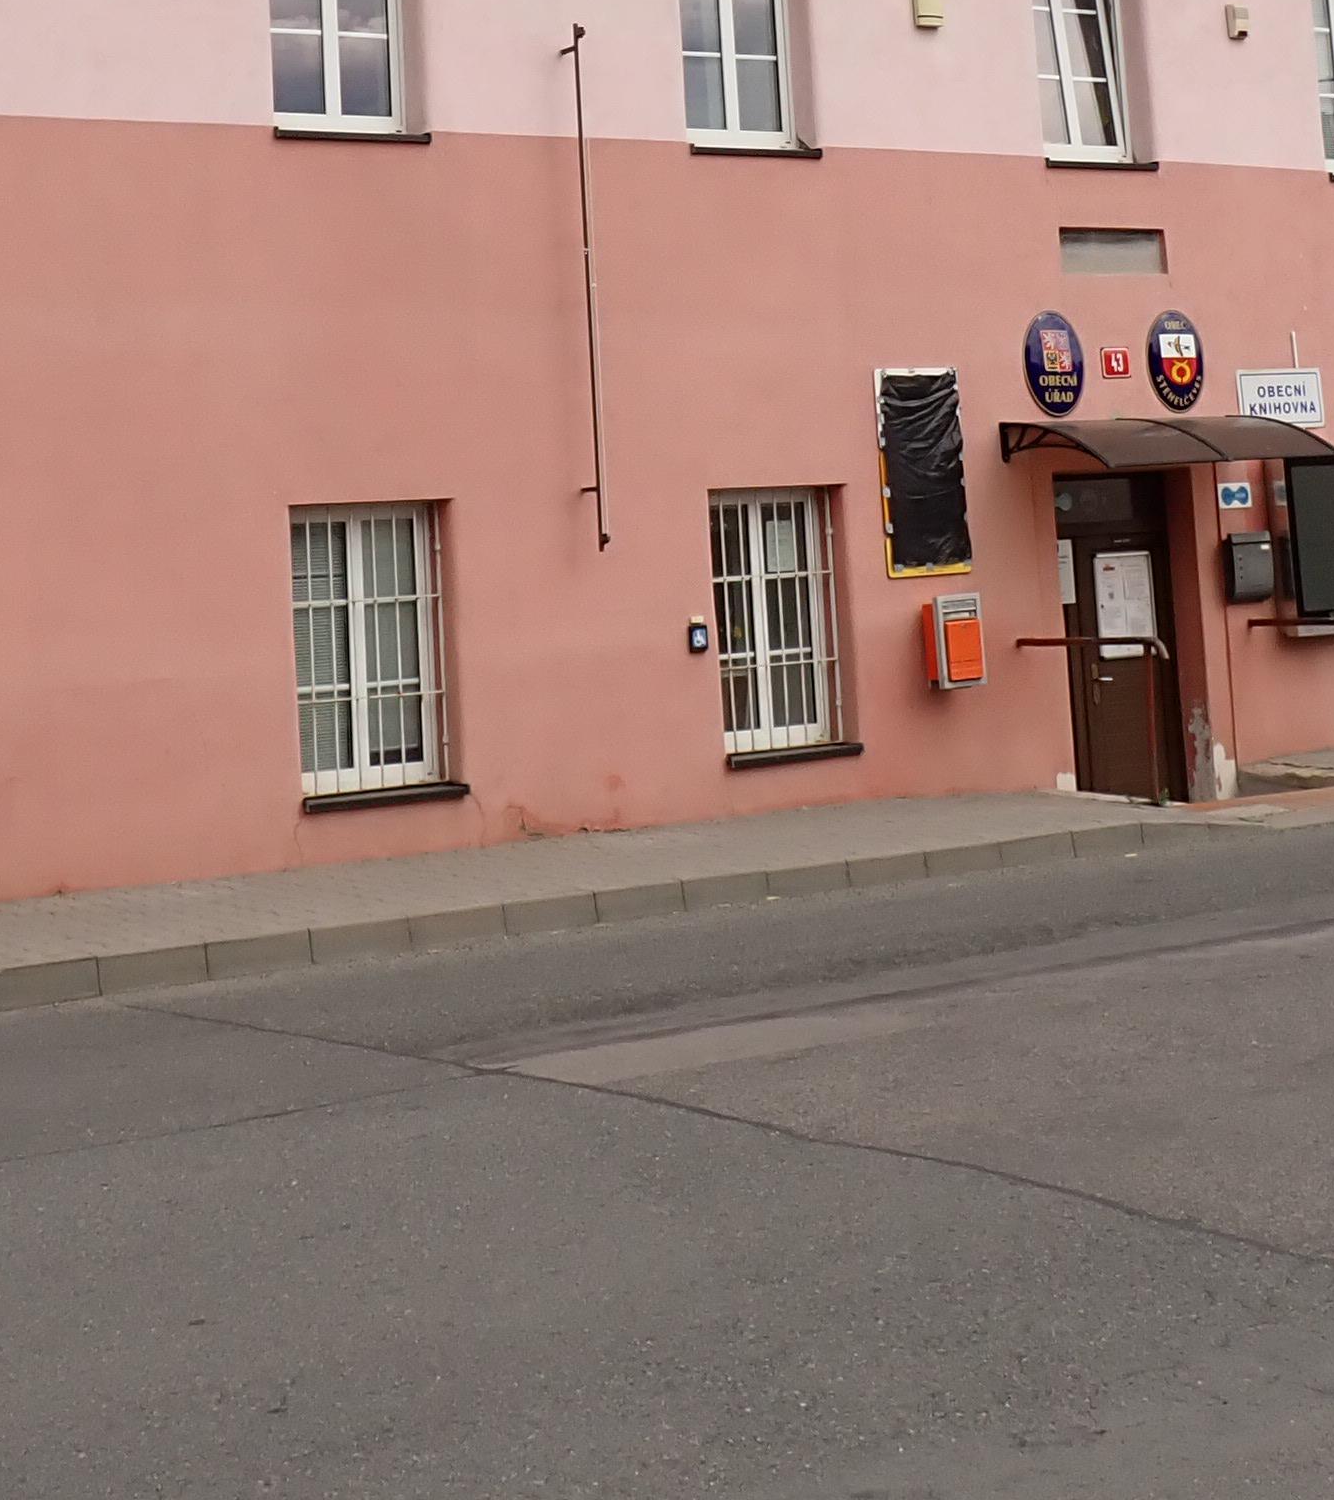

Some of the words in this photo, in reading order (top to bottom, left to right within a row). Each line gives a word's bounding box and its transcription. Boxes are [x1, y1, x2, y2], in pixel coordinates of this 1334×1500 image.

[1110, 353, 1124, 372] 43
[1039, 371, 1078, 387] OBECNÍ
[1044, 387, 1074, 403] ÚŘAD
[1257, 381, 1306, 398] OBECNÍ
[1249, 401, 1317, 416] KNIHOVNA
